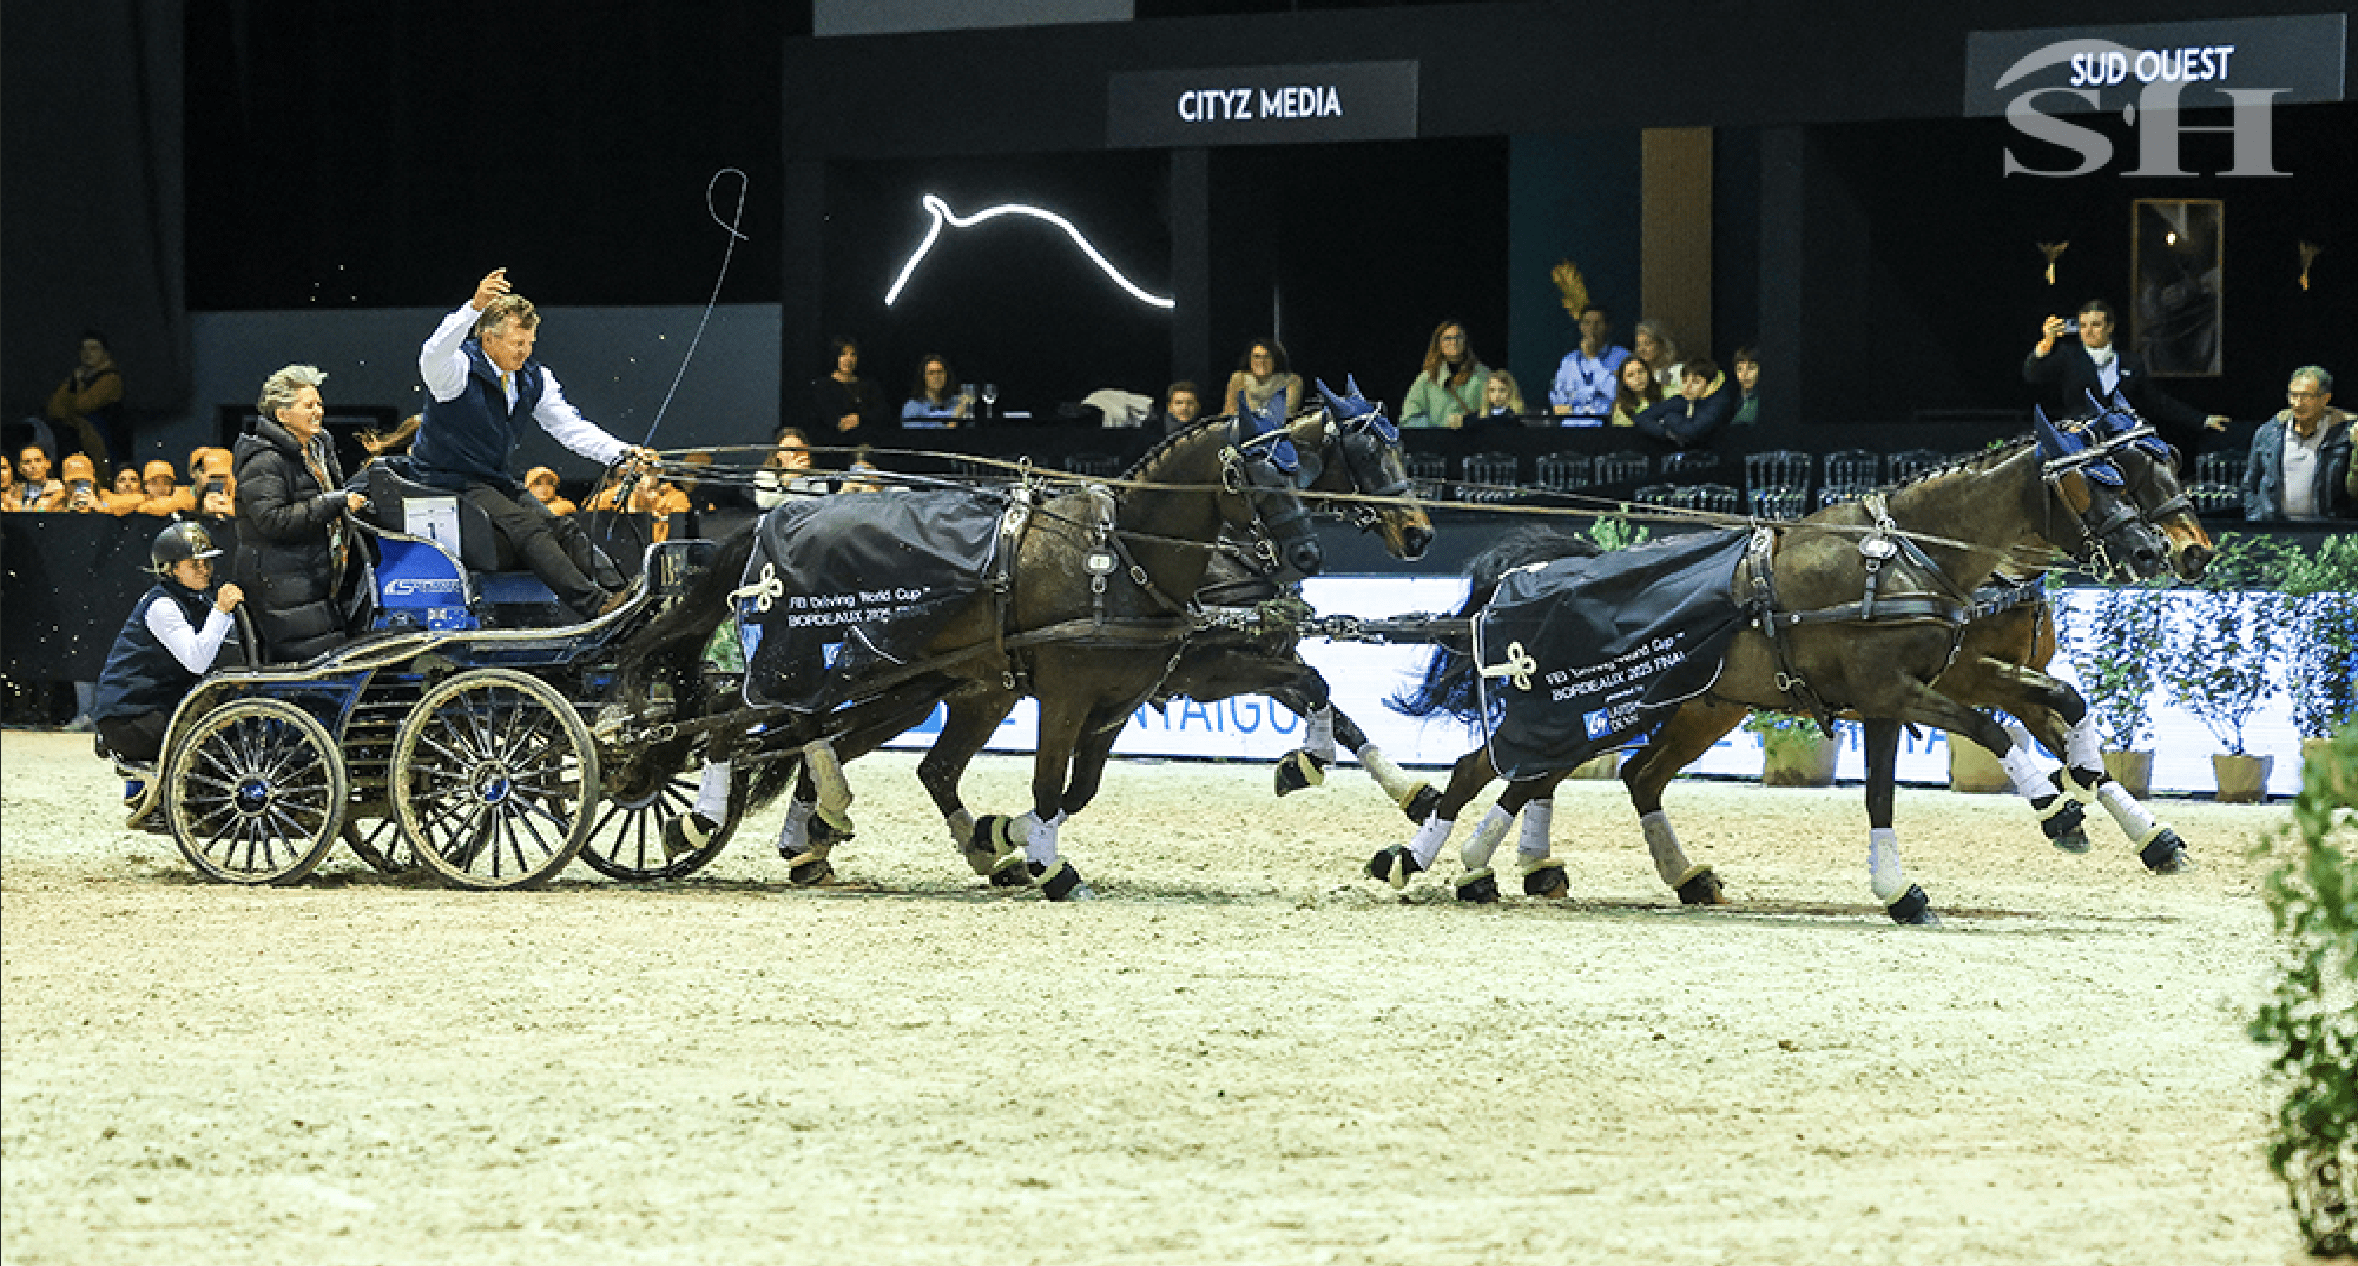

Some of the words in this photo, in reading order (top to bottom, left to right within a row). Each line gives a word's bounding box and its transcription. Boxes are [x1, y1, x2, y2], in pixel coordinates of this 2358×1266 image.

[2069, 51, 2129, 87] SUD
[2134, 45, 2235, 83] OUEST
[1177, 88, 1253, 122] CITYZ
[1259, 86, 1344, 119] MEDIA
[1552, 671, 1624, 701] BORDEAUX
